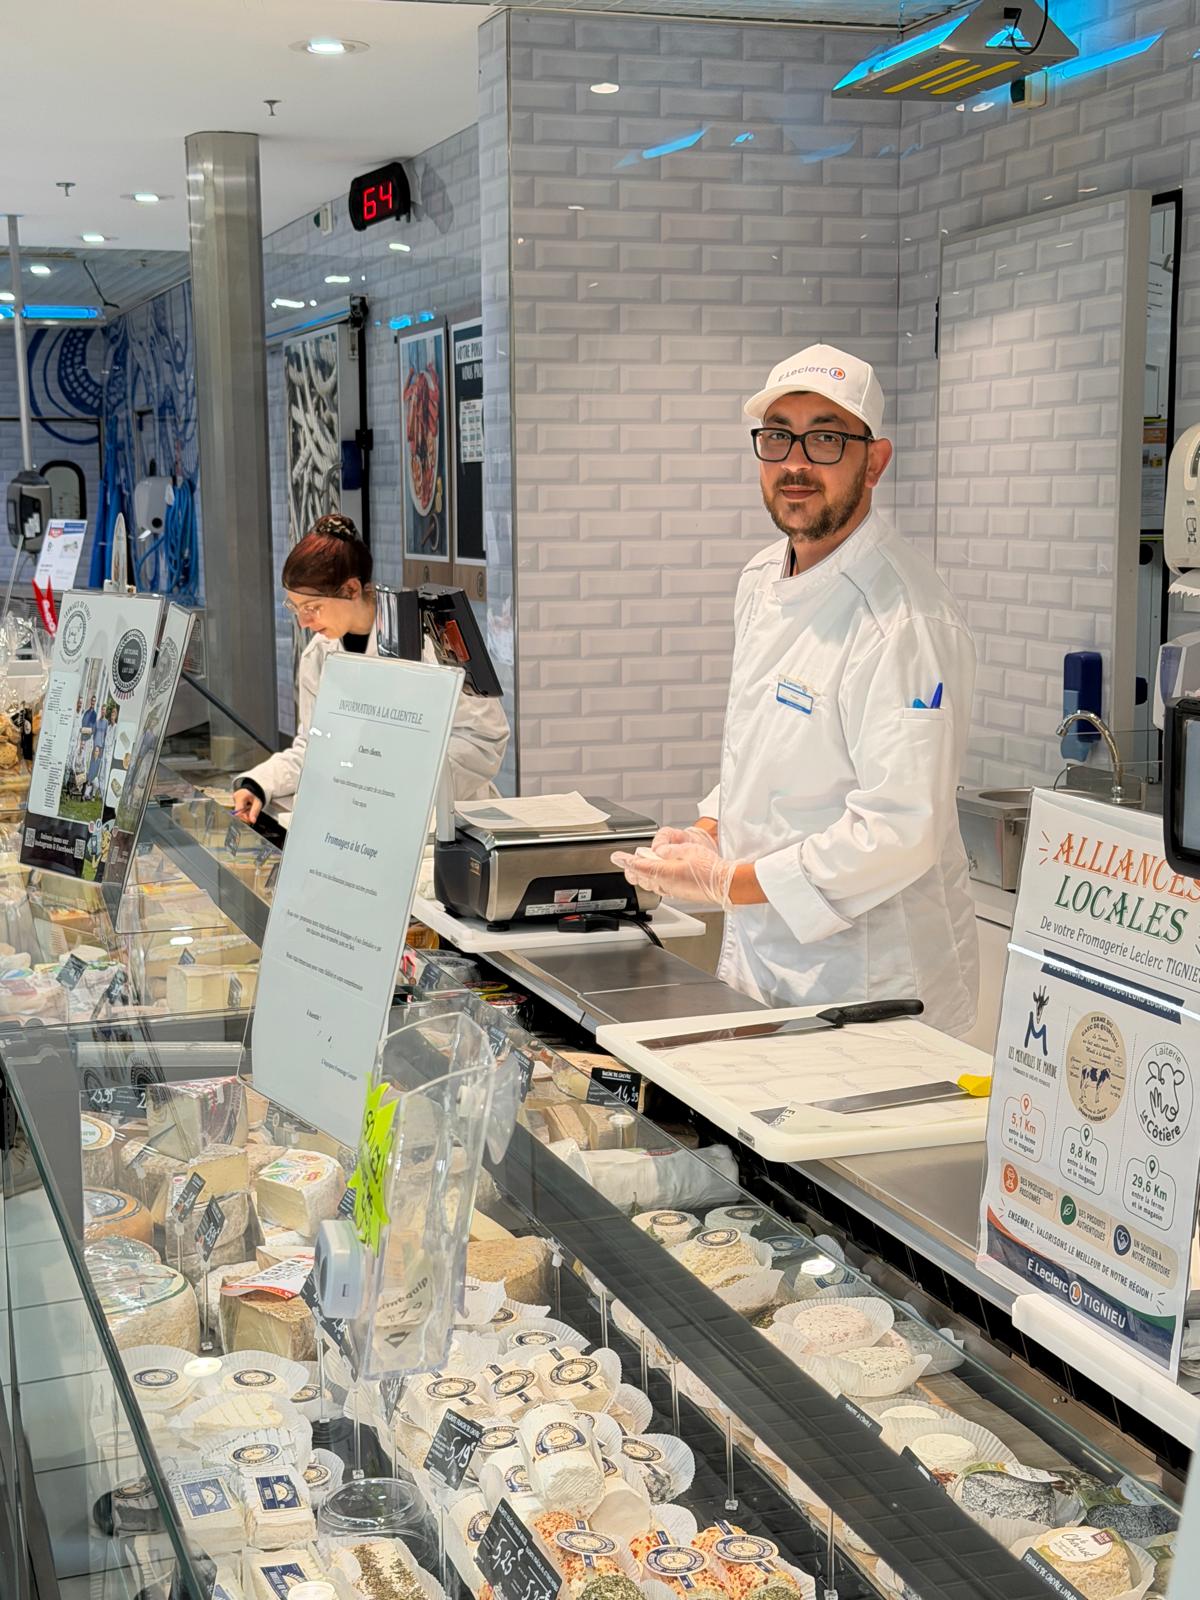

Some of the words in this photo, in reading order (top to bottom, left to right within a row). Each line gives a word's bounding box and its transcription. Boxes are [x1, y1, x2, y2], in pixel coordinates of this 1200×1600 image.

[363, 181, 393, 220] 64
[1055, 874, 1189, 944] LOCALES
[1040, 915, 1053, 930] De
[1053, 922, 1074, 939] votre
[1076, 927, 1128, 957] Fromagerie
[1129, 945, 1164, 970] Leclerc
[1166, 957, 1200, 984] TIGNIE
[1155, 1045, 1182, 1064] Laiterie
[1011, 1112, 1023, 1128] 5,1
[1024, 1119, 1036, 1135] Km
[1146, 1119, 1181, 1142] Côtière
[1009, 1128, 1019, 1136] entre
[1024, 1134, 1036, 1145] ferme
[1070, 1142, 1083, 1158] 8,8
[1084, 1149, 1098, 1166] Km
[1067, 1158, 1078, 1167] entre
[1085, 1166, 1097, 1177] ferme
[1078, 1174, 1096, 1187] magasin
[1132, 1173, 1151, 1193] 29,6
[1153, 1184, 1168, 1201] Km
[1131, 1191, 1144, 1201] entre
[1145, 1196, 1150, 1205] la
[1151, 1199, 1165, 1212] ferme
[1143, 1208, 1163, 1222] magasin
[1008, 1209, 1035, 1233] ENSEMBLE,
[1036, 1226, 1068, 1252] VALORISONS
[1068, 1245, 1075, 1255] LE
[1075, 1249, 1101, 1270] MEILLEUR
[1101, 1264, 1110, 1275] DE
[1110, 1269, 1128, 1287] NOTRE
[1128, 1280, 1149, 1301] RÉGION
[1131, 1249, 1145, 1264] NOTRE
[1083, 1291, 1127, 1329] TIGNIEU
